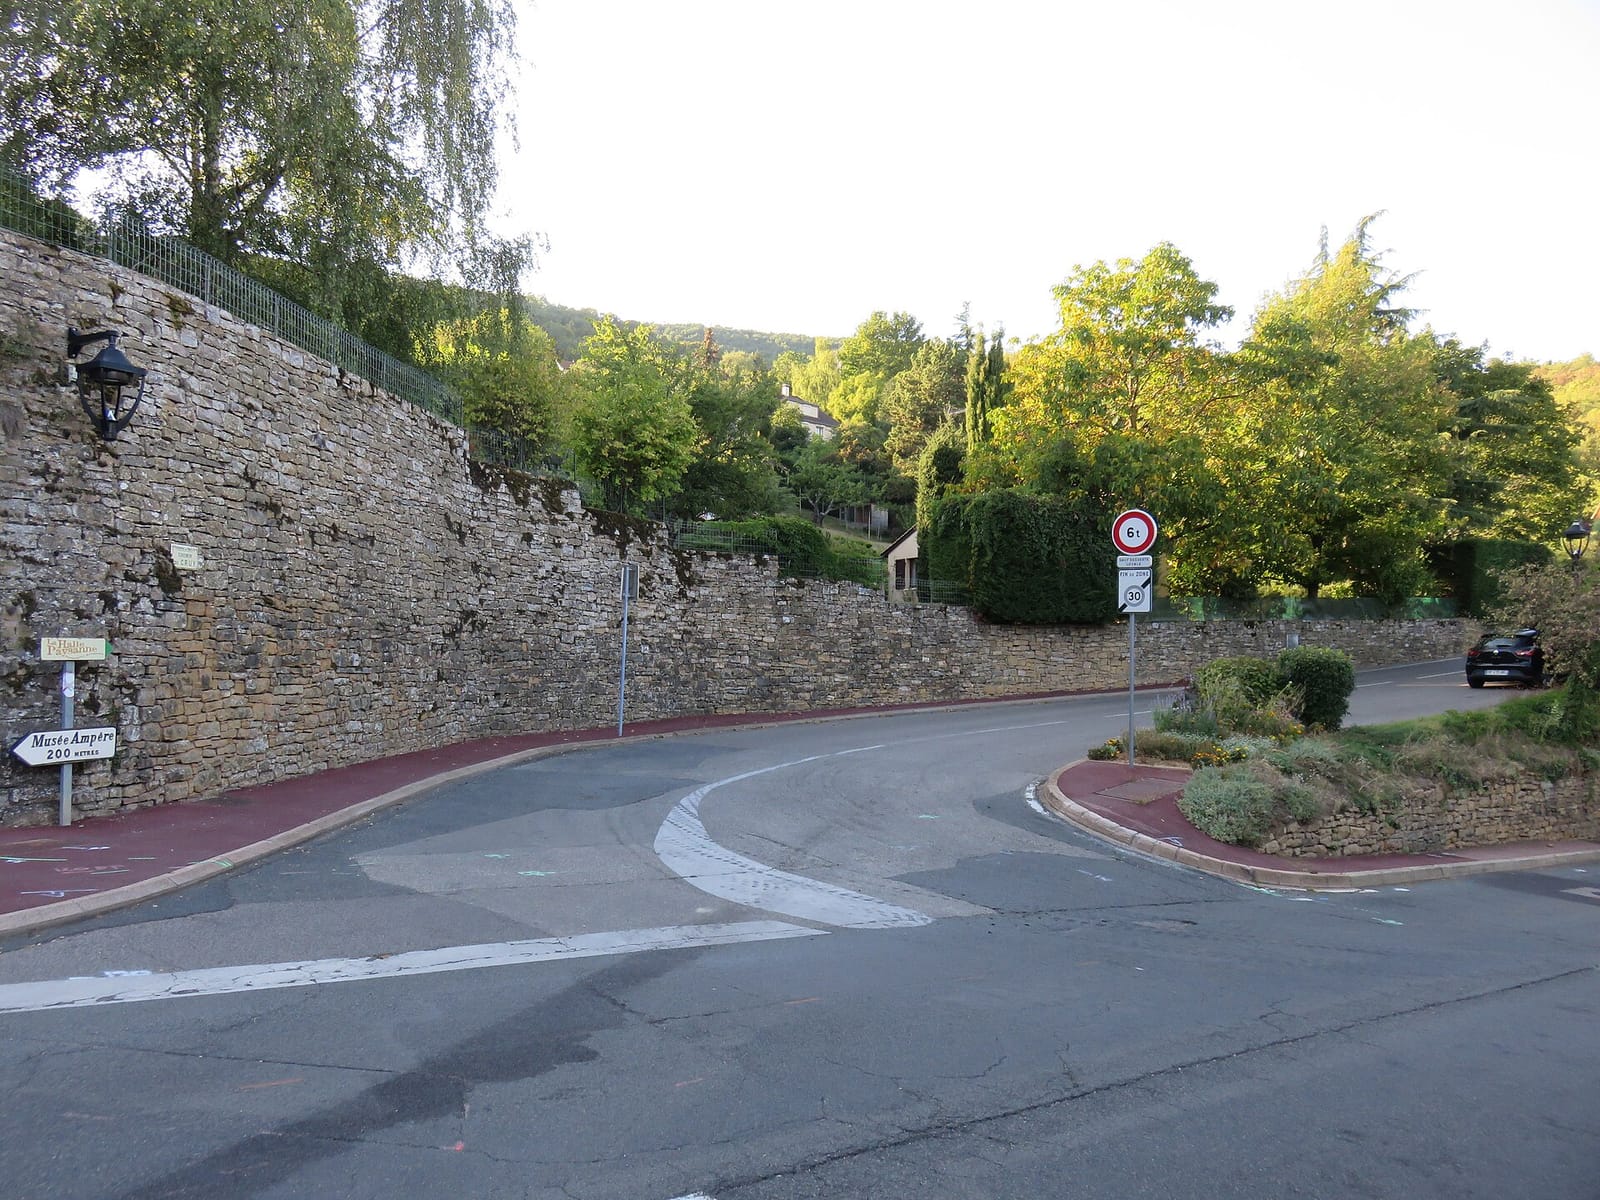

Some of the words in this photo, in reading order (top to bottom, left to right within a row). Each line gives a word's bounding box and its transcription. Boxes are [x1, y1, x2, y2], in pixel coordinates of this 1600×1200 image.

[1128, 591, 1141, 601] 30
[58, 640, 84, 649] Halle
[47, 645, 97, 656] Paysanne
[31, 734, 69, 748] Musée
[70, 731, 114, 746] Ampère
[47, 748, 71, 760] 200
